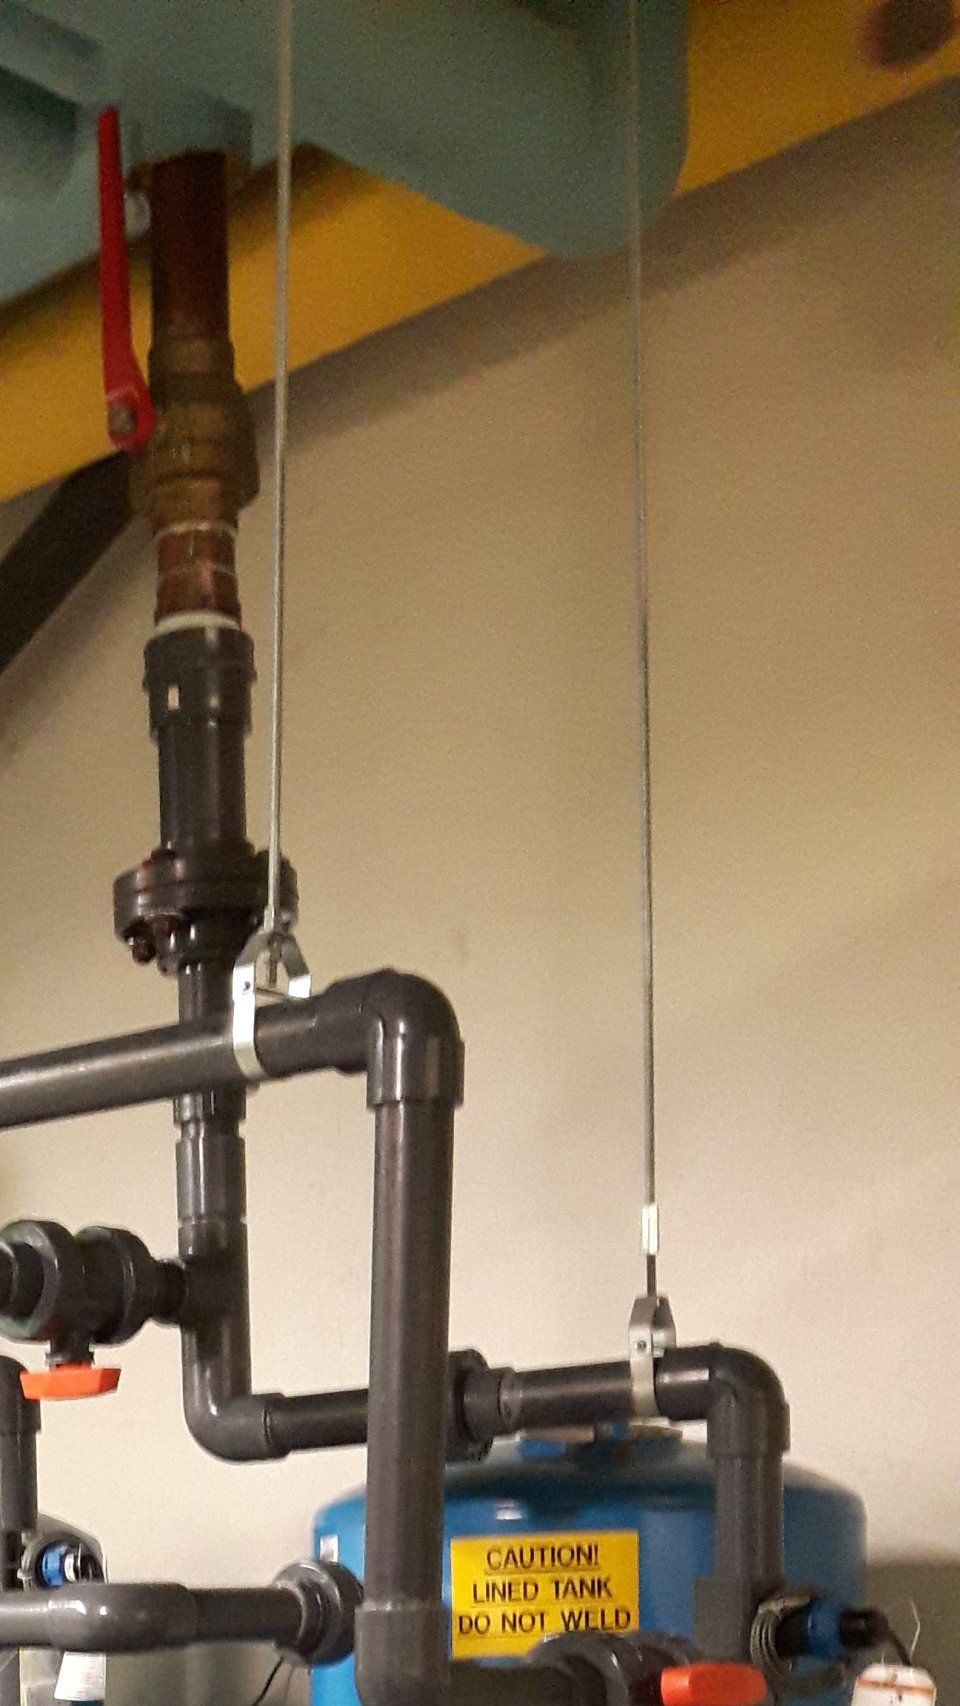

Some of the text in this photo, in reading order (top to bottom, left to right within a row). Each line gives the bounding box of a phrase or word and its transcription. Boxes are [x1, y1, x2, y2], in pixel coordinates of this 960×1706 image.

[486, 1544, 599, 1571] CAUTION!
[472, 1576, 613, 1604] LINED TANK
[458, 1606, 631, 1635] DO NOT WELD
